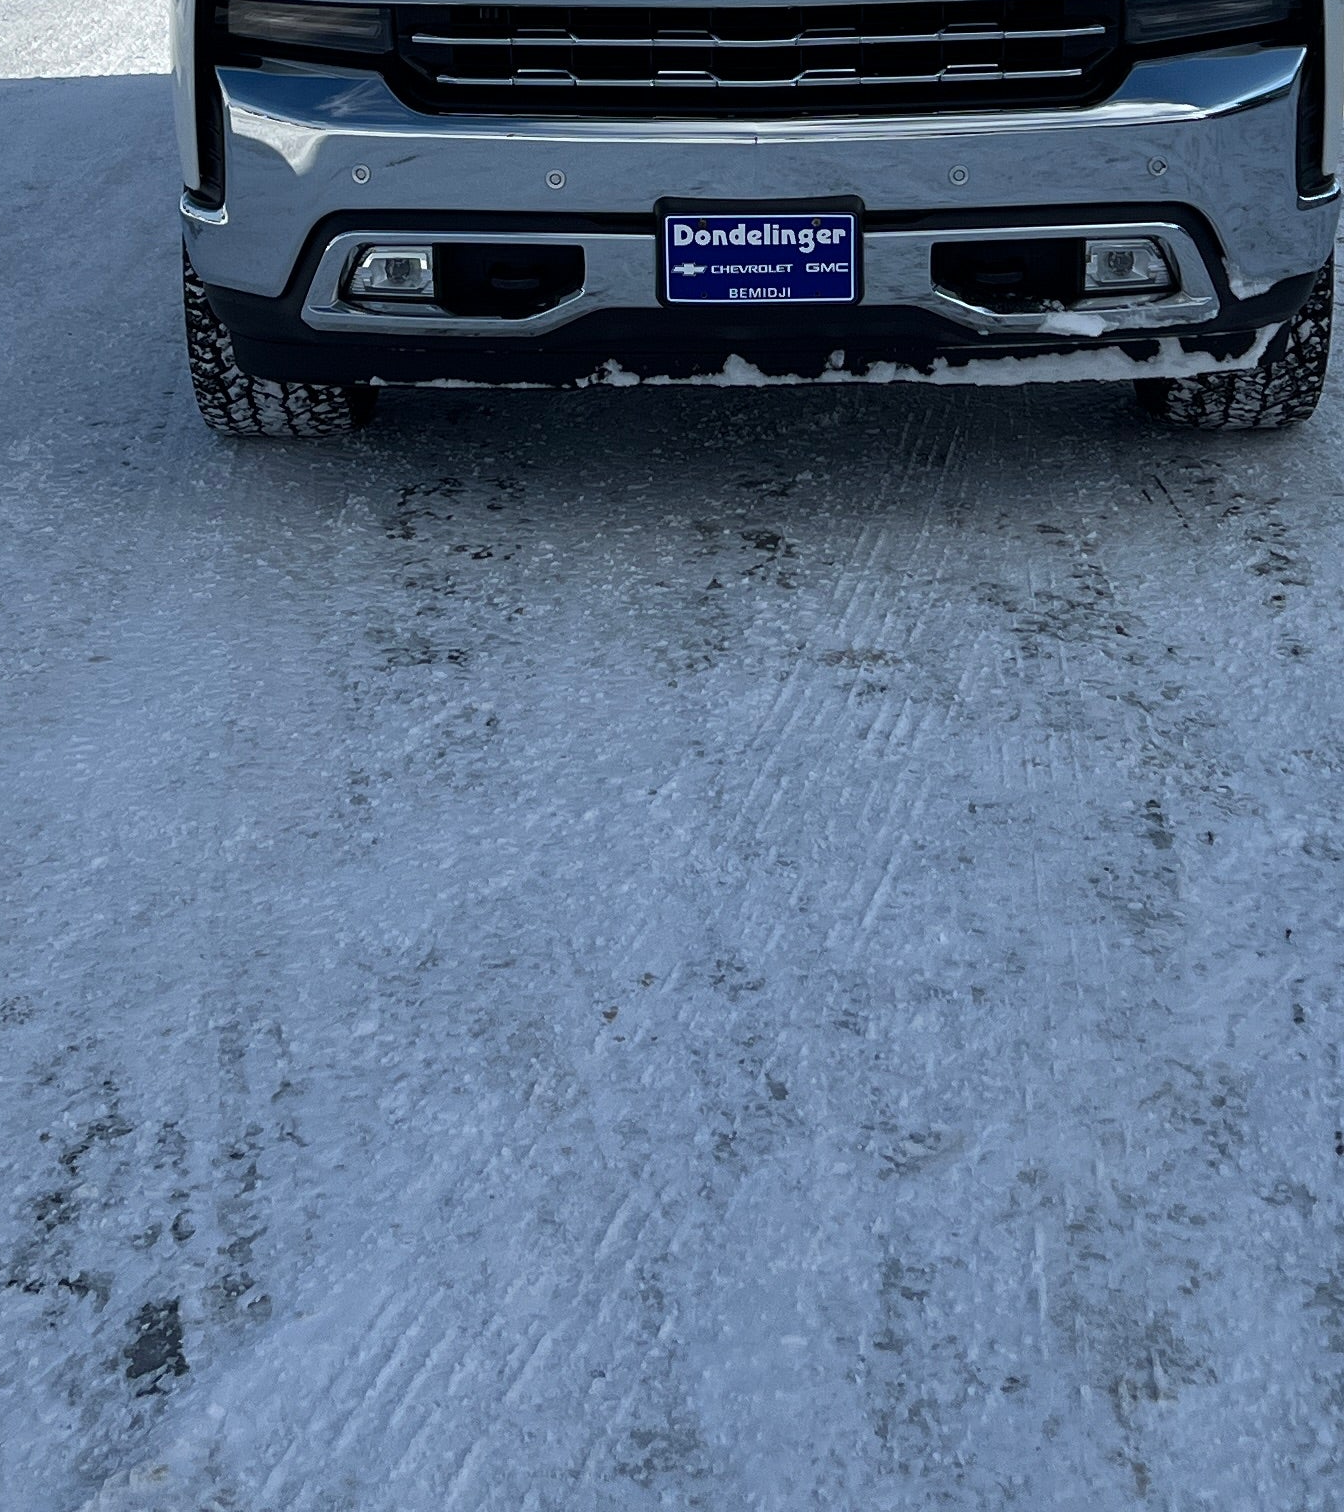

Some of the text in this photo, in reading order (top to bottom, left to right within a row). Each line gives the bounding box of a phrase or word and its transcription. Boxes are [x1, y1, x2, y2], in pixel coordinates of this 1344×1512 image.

[673, 223, 846, 253] Dondelinger
[711, 262, 849, 274] CHEVROLET GMC
[729, 287, 791, 298] BEMIDJI
